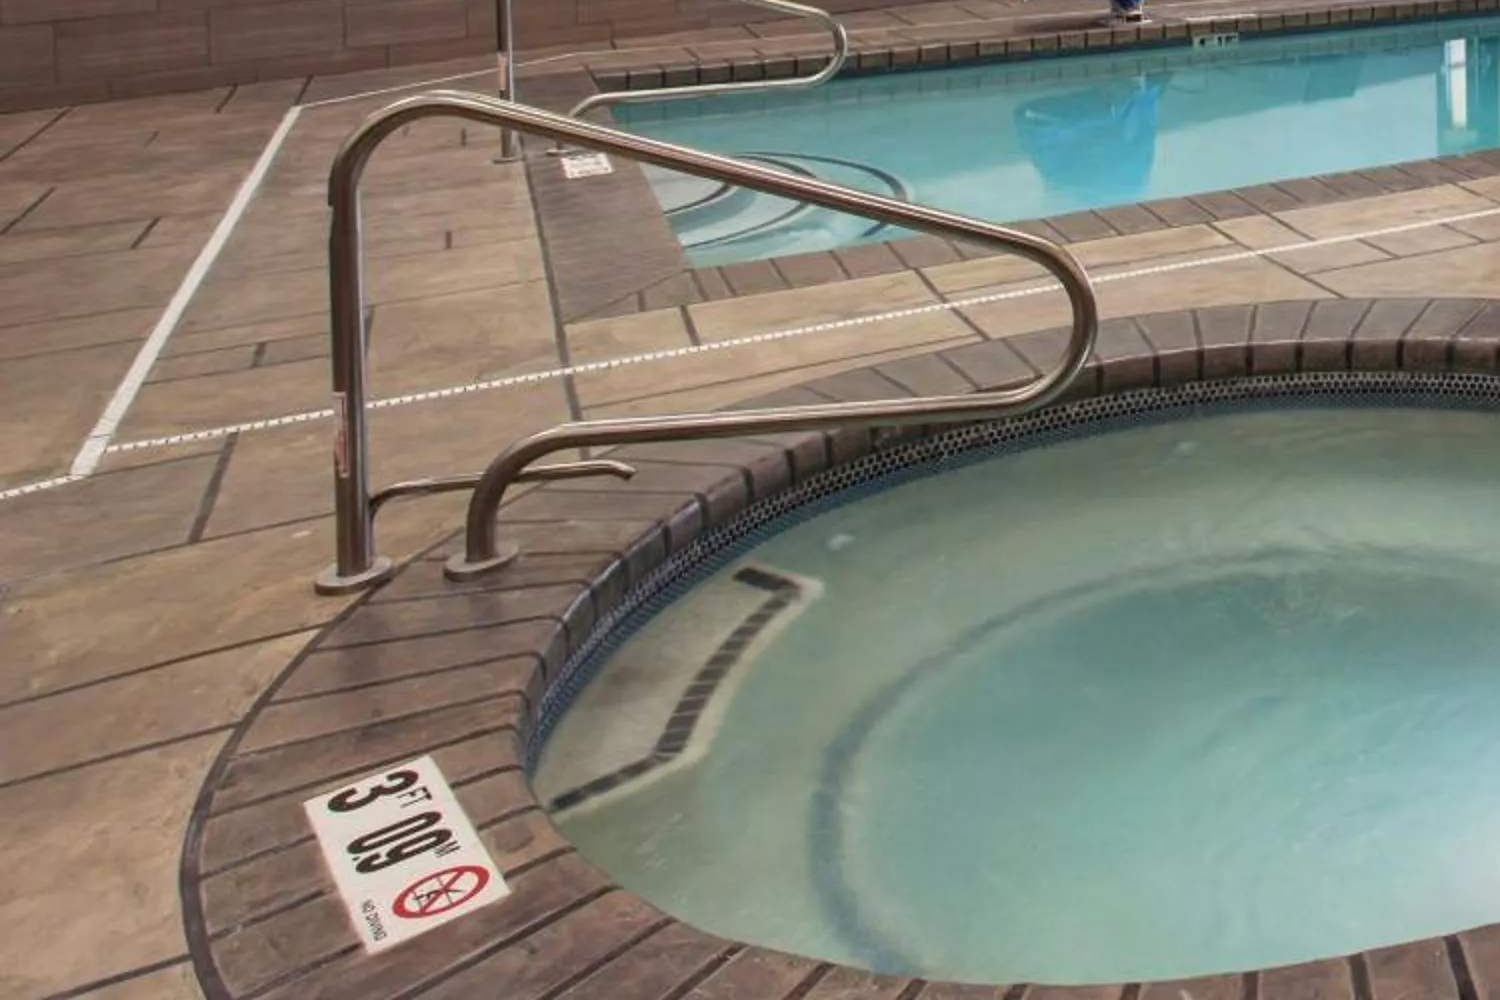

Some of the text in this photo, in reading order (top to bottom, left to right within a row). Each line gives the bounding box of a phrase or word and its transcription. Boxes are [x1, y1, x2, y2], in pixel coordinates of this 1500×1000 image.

[327, 769, 420, 813] 3
[397, 786, 433, 809] FT
[361, 898, 388, 942] NO DIVING
